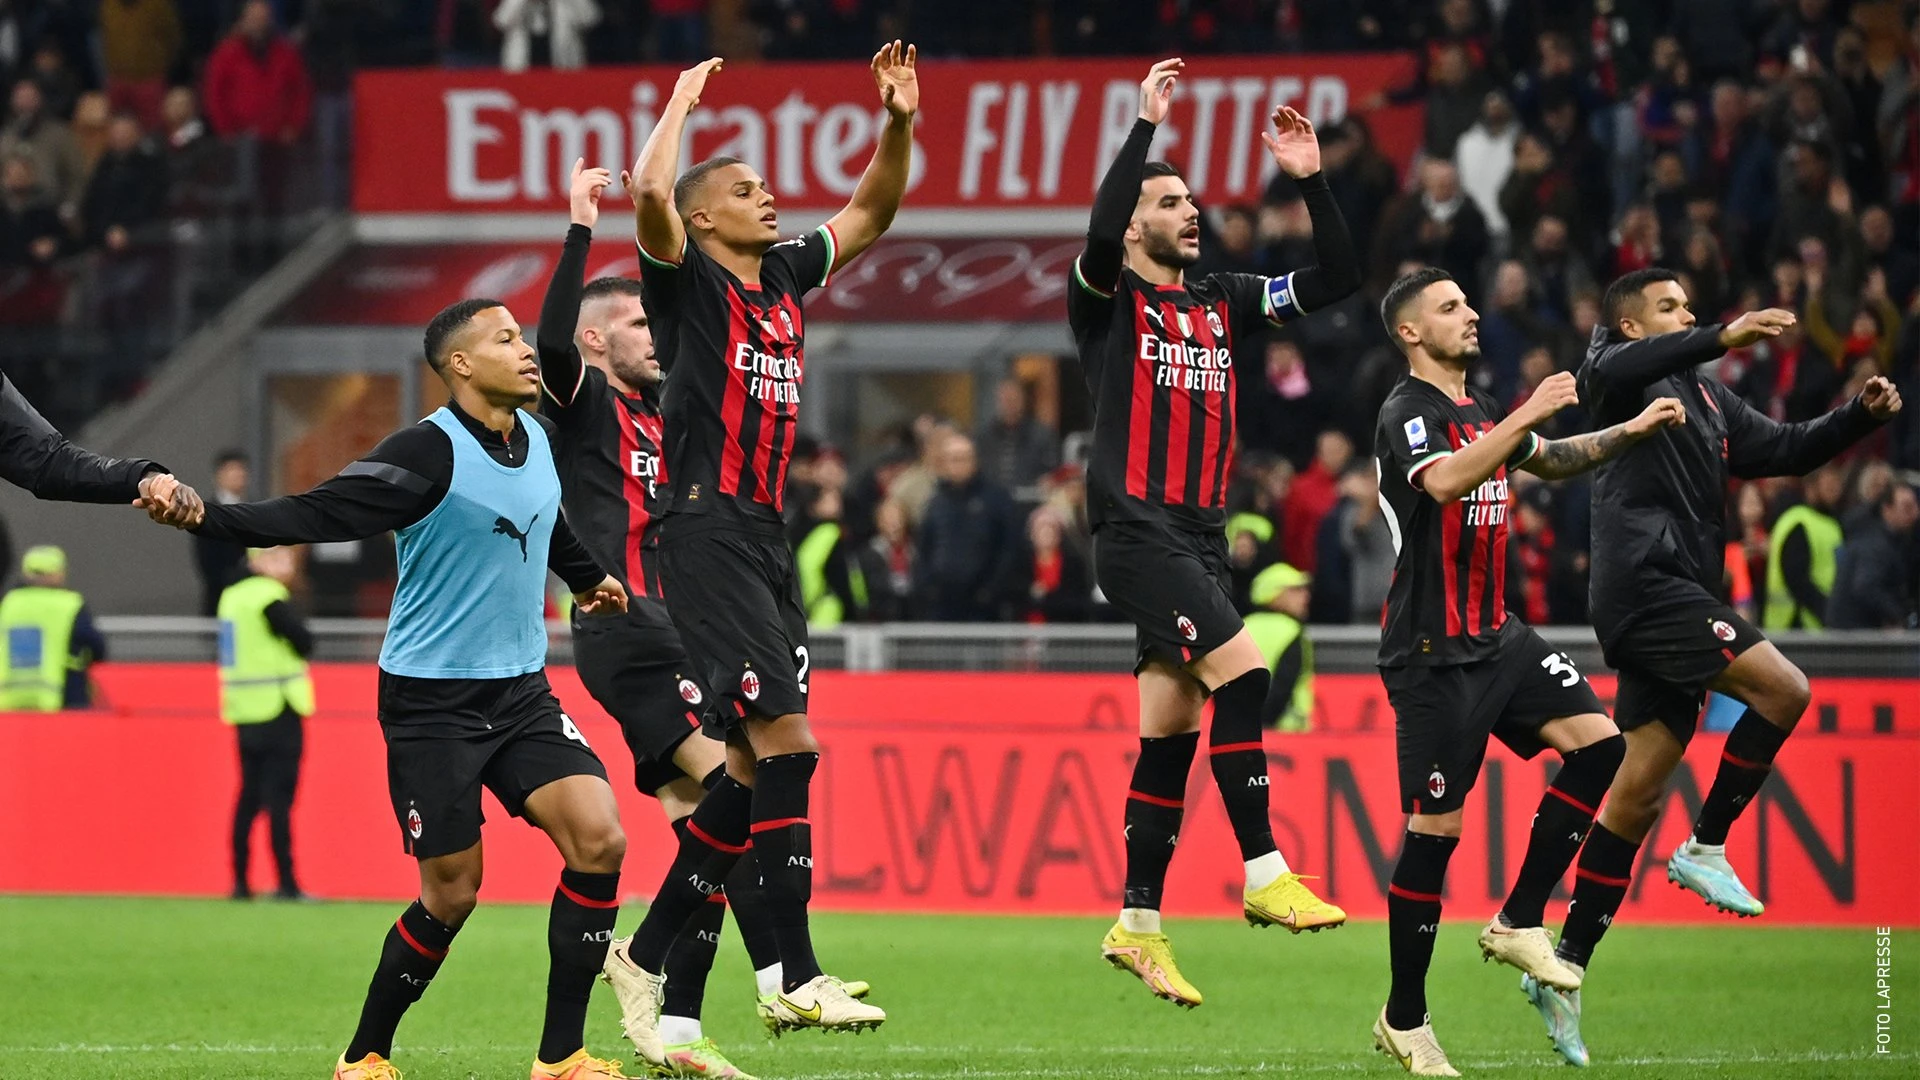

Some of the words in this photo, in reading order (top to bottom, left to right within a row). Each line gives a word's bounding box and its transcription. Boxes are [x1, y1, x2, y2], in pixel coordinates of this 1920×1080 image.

[958, 81, 1080, 199] FLY
[1140, 333, 1232, 369] Emirate
[749, 376, 773, 401] FLY
[1156, 364, 1181, 387] FLY
[1184, 368, 1227, 392] BETTER
[1467, 504, 1488, 526] FLY
[1541, 651, 1588, 688] 3
[560, 713, 590, 748] 4
